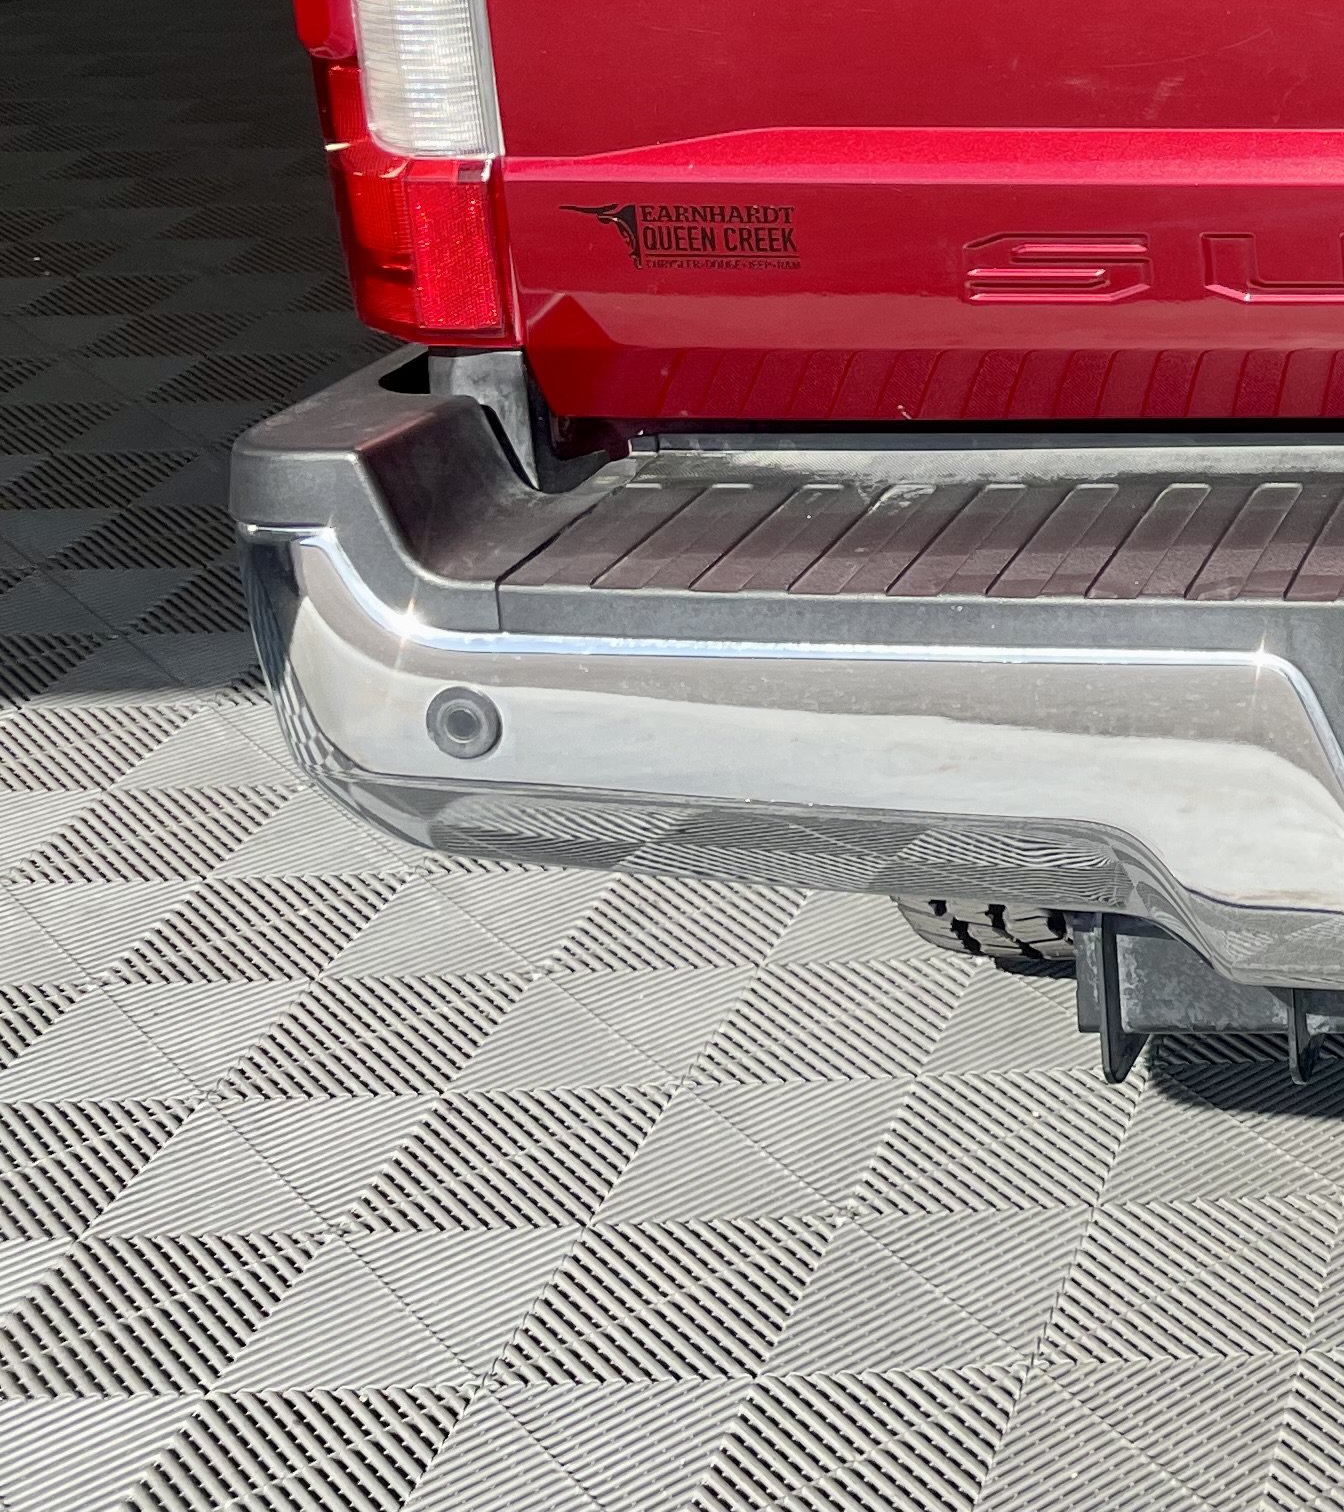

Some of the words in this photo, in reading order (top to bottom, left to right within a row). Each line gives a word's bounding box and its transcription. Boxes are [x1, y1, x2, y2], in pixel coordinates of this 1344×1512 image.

[639, 205, 795, 224] EARNHARDT
[642, 226, 716, 252] QUEEN
[723, 227, 798, 253] CREEK
